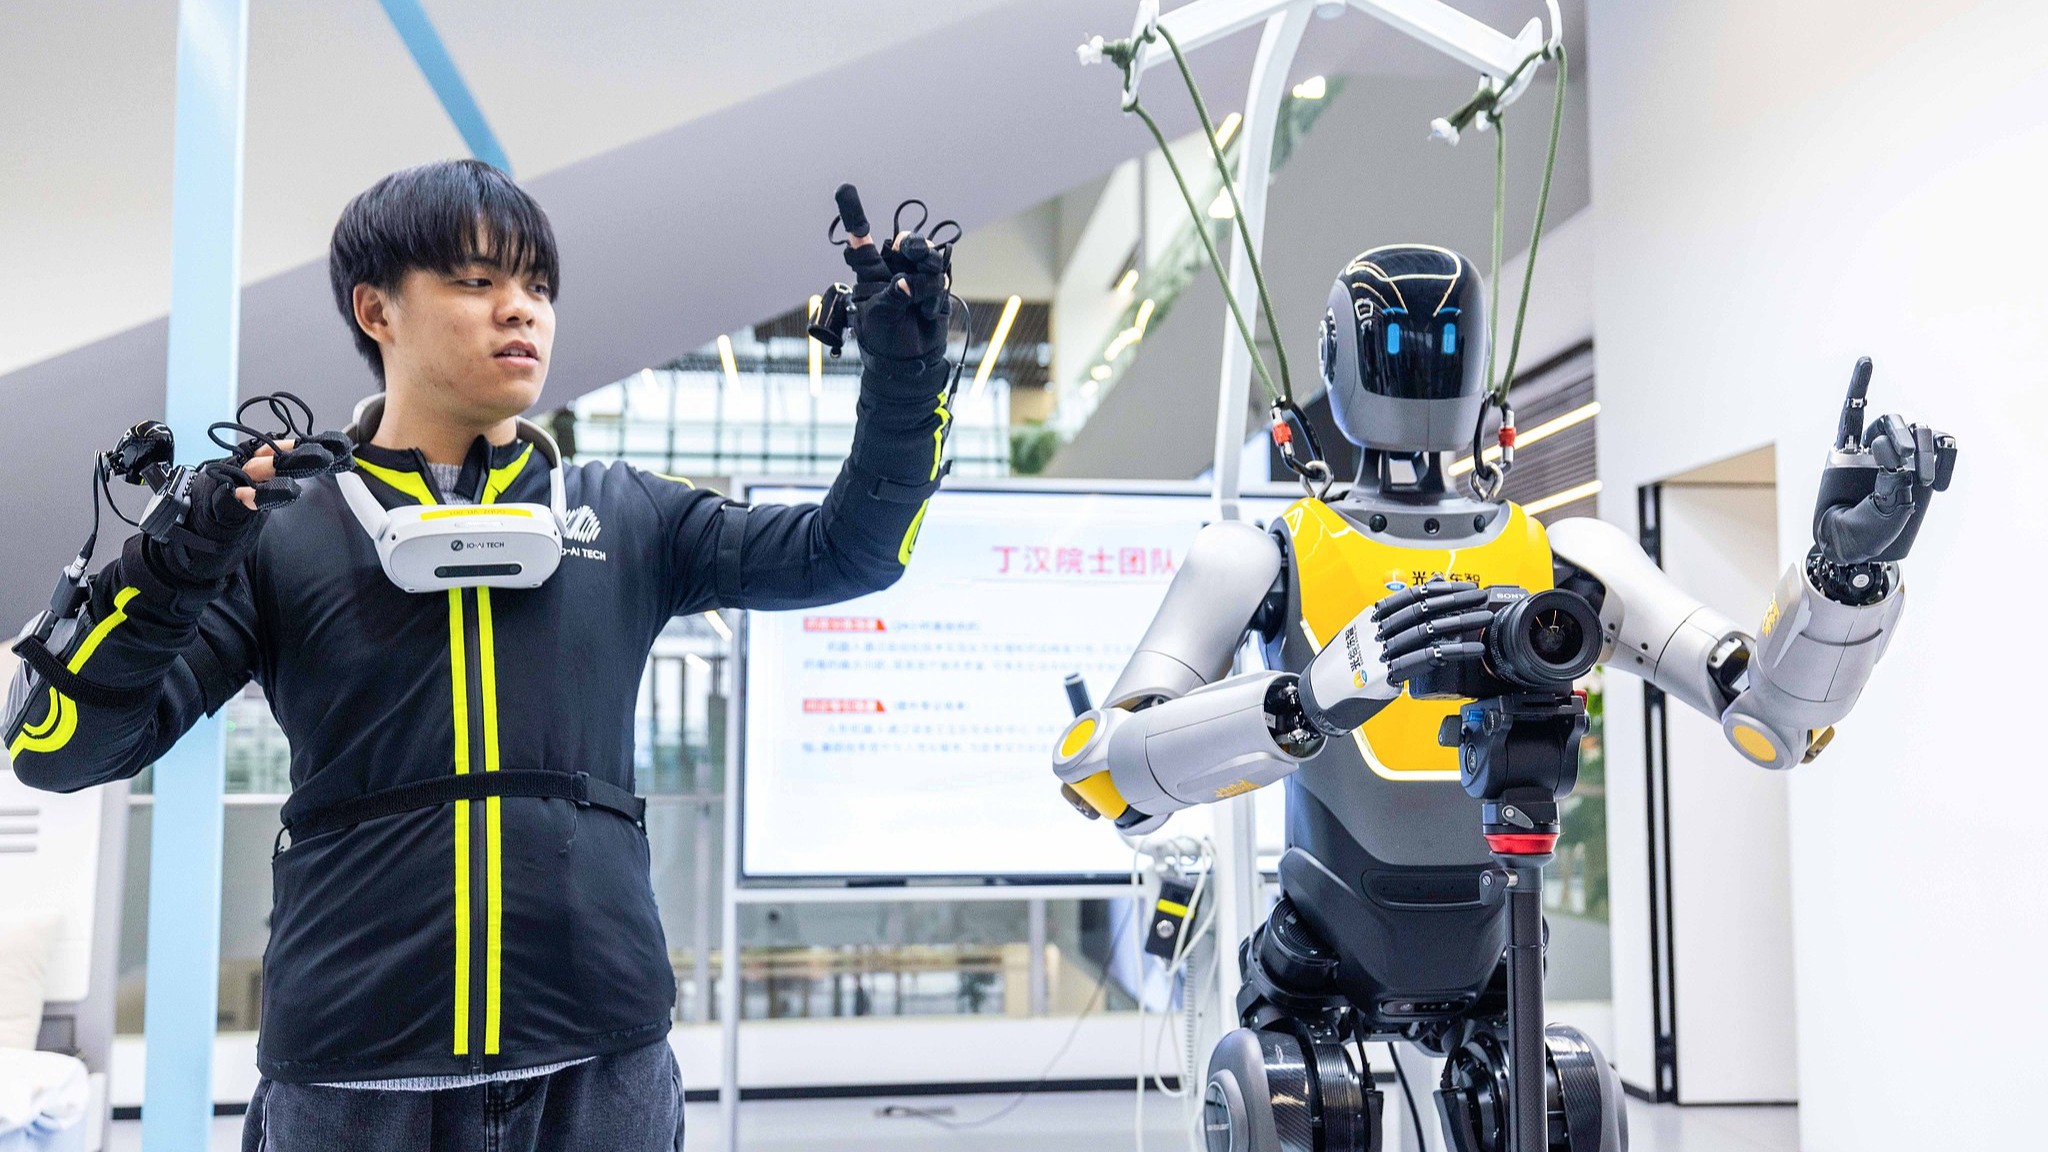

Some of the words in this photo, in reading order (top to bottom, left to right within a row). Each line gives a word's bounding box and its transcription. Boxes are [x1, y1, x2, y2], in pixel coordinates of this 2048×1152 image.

[486, 541, 505, 549] TECH
[561, 546, 580, 557] O-AI
[581, 548, 606, 561] TECH
[992, 546, 1177, 574] 丁汉院士团队
